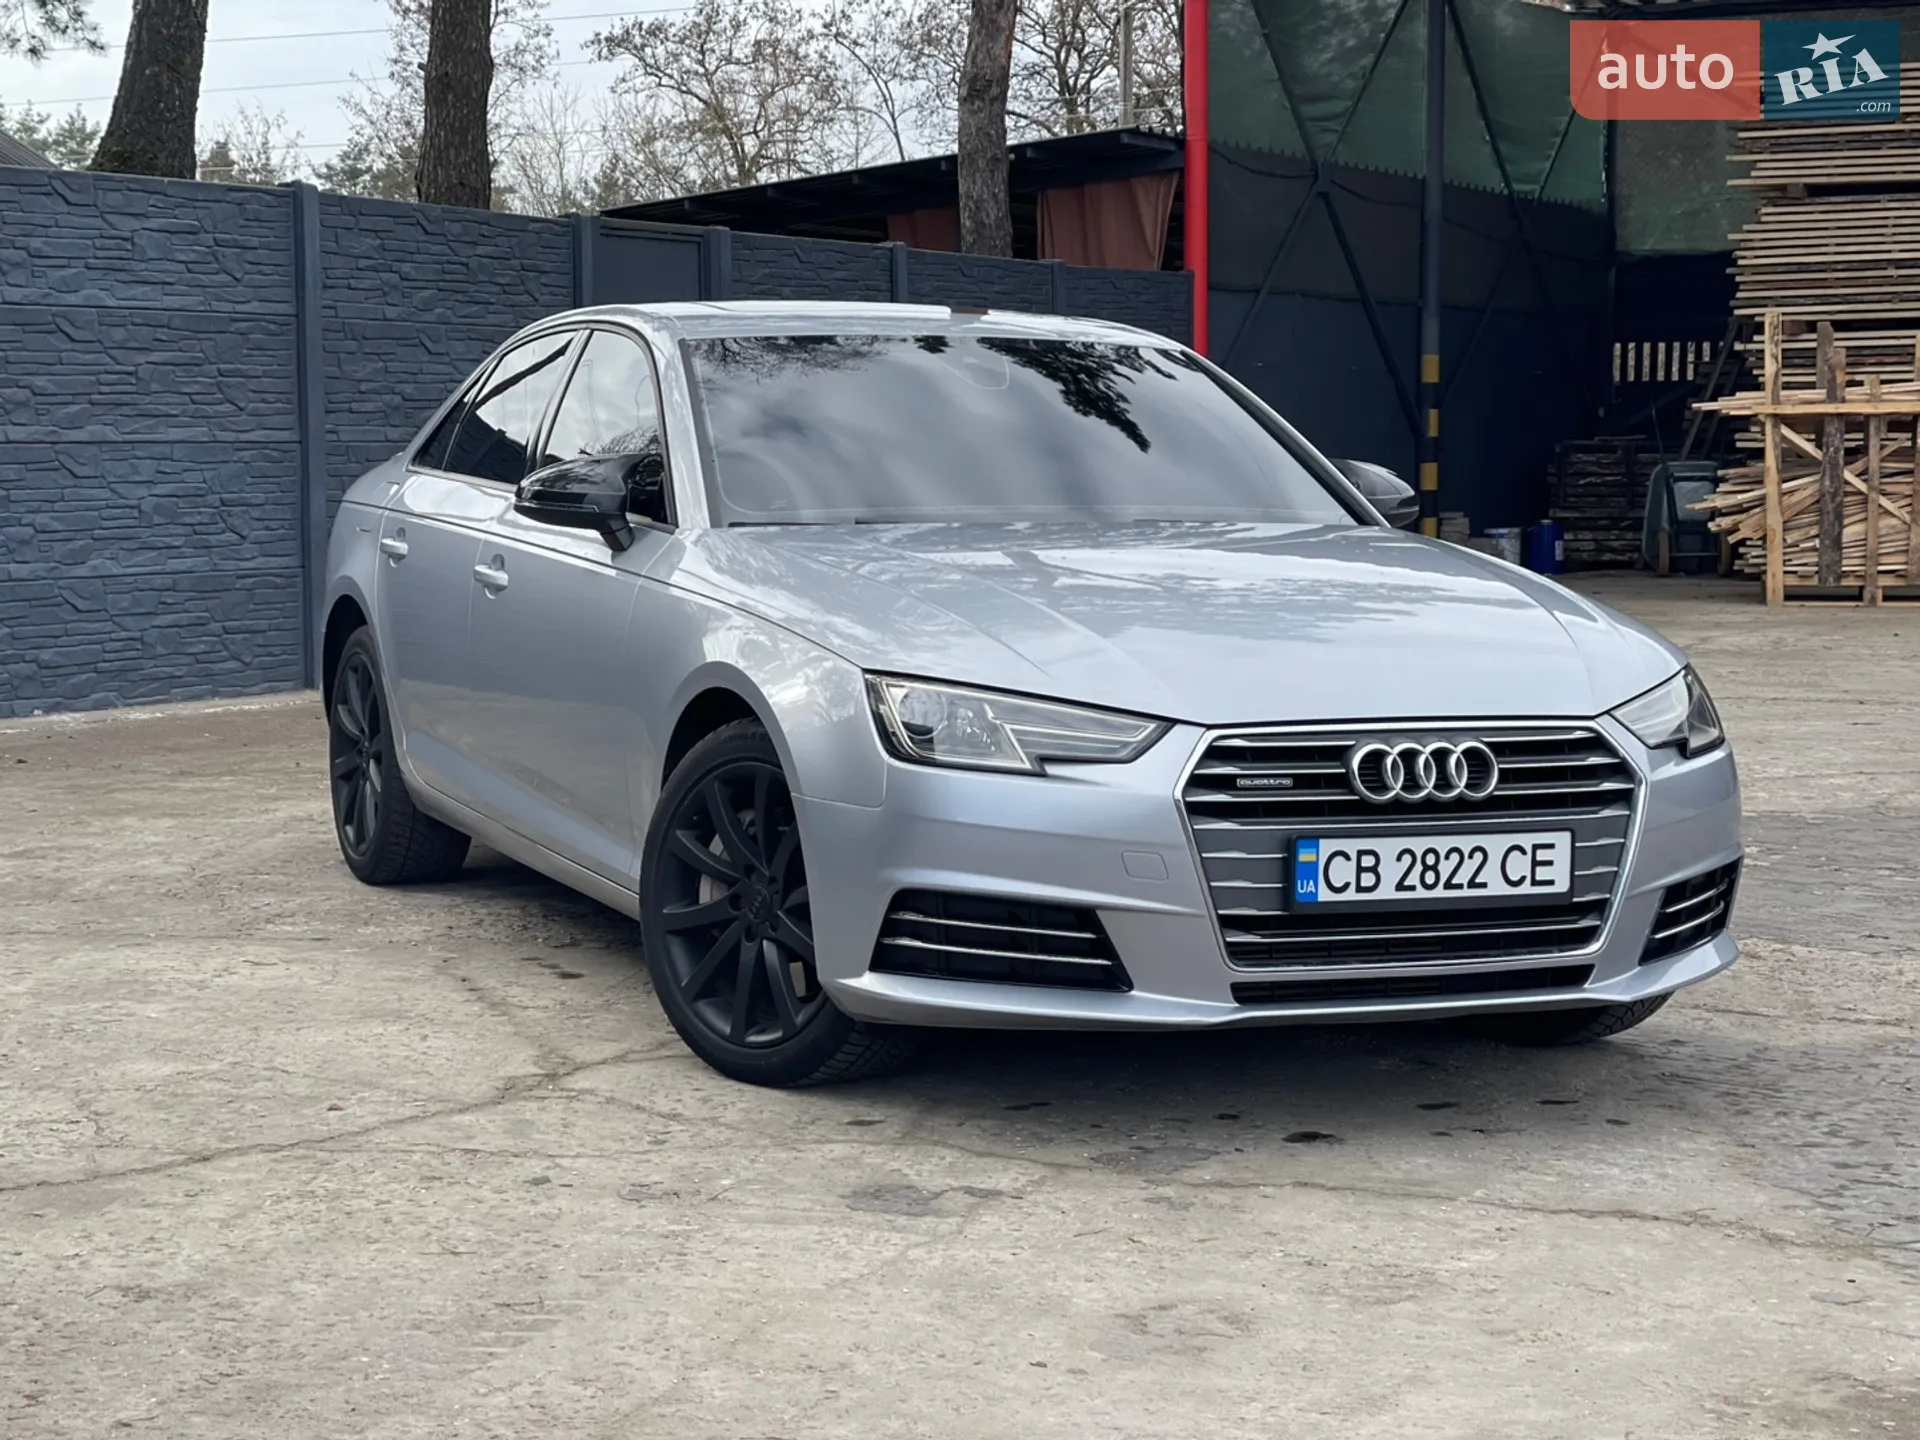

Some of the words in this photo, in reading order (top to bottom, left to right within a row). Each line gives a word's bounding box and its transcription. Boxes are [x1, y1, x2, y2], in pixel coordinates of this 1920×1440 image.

[1239, 778, 1292, 787] quattro
[1322, 850, 1382, 893] CB
[1395, 845, 1489, 892] 2822
[1500, 843, 1556, 888] CE
[1298, 880, 1316, 894] UA
